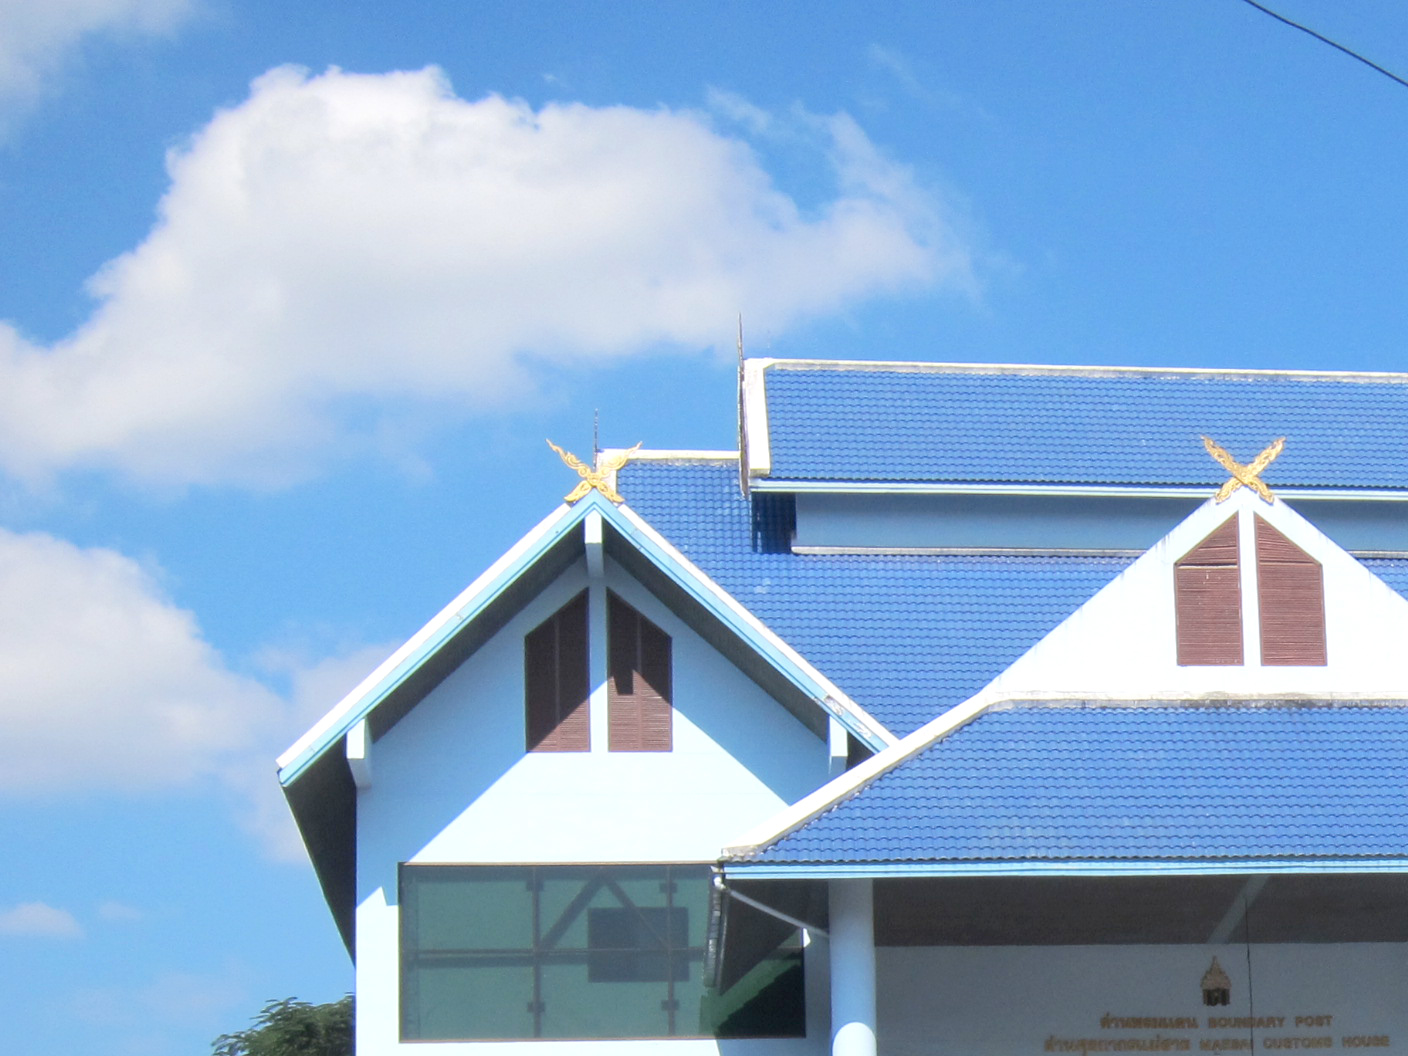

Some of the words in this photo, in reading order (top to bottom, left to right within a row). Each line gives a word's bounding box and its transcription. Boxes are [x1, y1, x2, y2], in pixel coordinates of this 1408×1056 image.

[1207, 1016, 1285, 1028] BOUNDARY
[1295, 1015, 1333, 1027] POST
[1263, 1036, 1333, 1049] CUSTOMS
[1341, 1035, 1390, 1048] HOUSE
